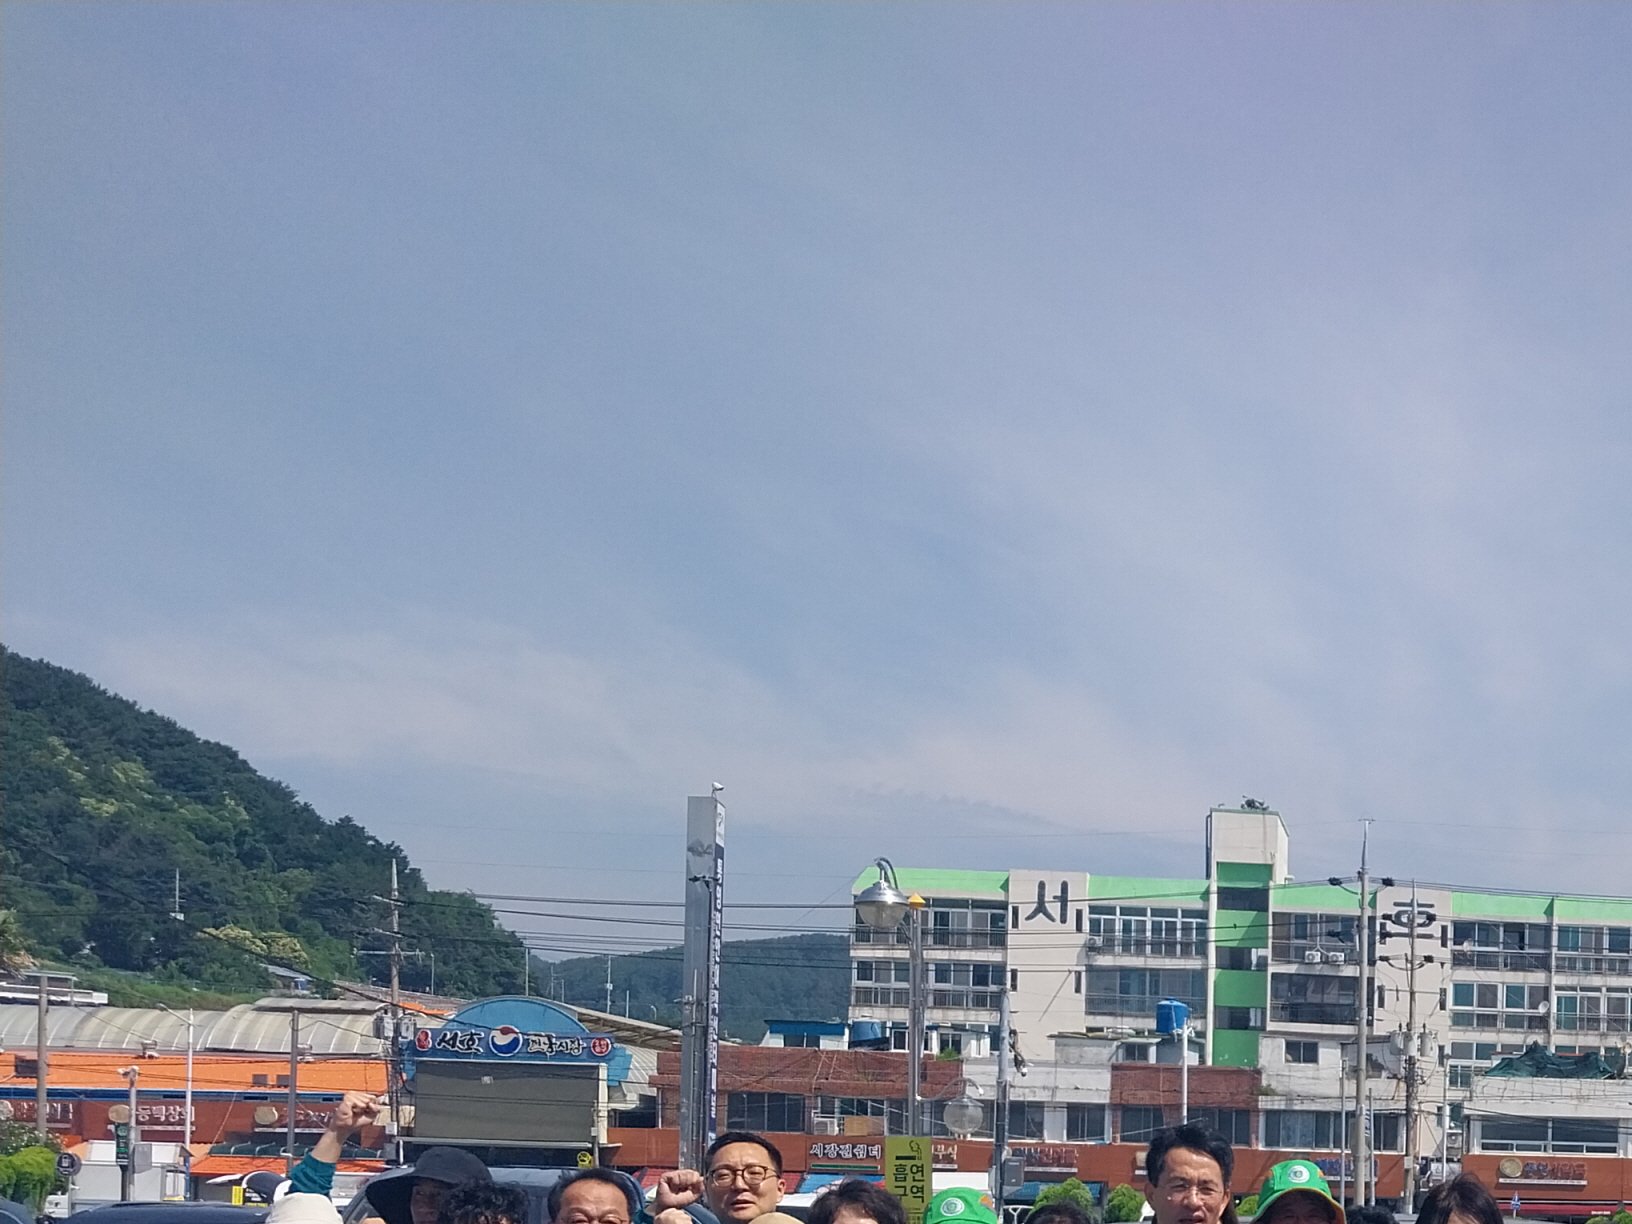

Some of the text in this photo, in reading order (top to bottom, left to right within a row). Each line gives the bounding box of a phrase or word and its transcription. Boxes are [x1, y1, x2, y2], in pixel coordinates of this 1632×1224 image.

[1024, 879, 1069, 925] 서
[893, 1163, 926, 1183] 흡연
[894, 1185, 926, 1204] 구역
